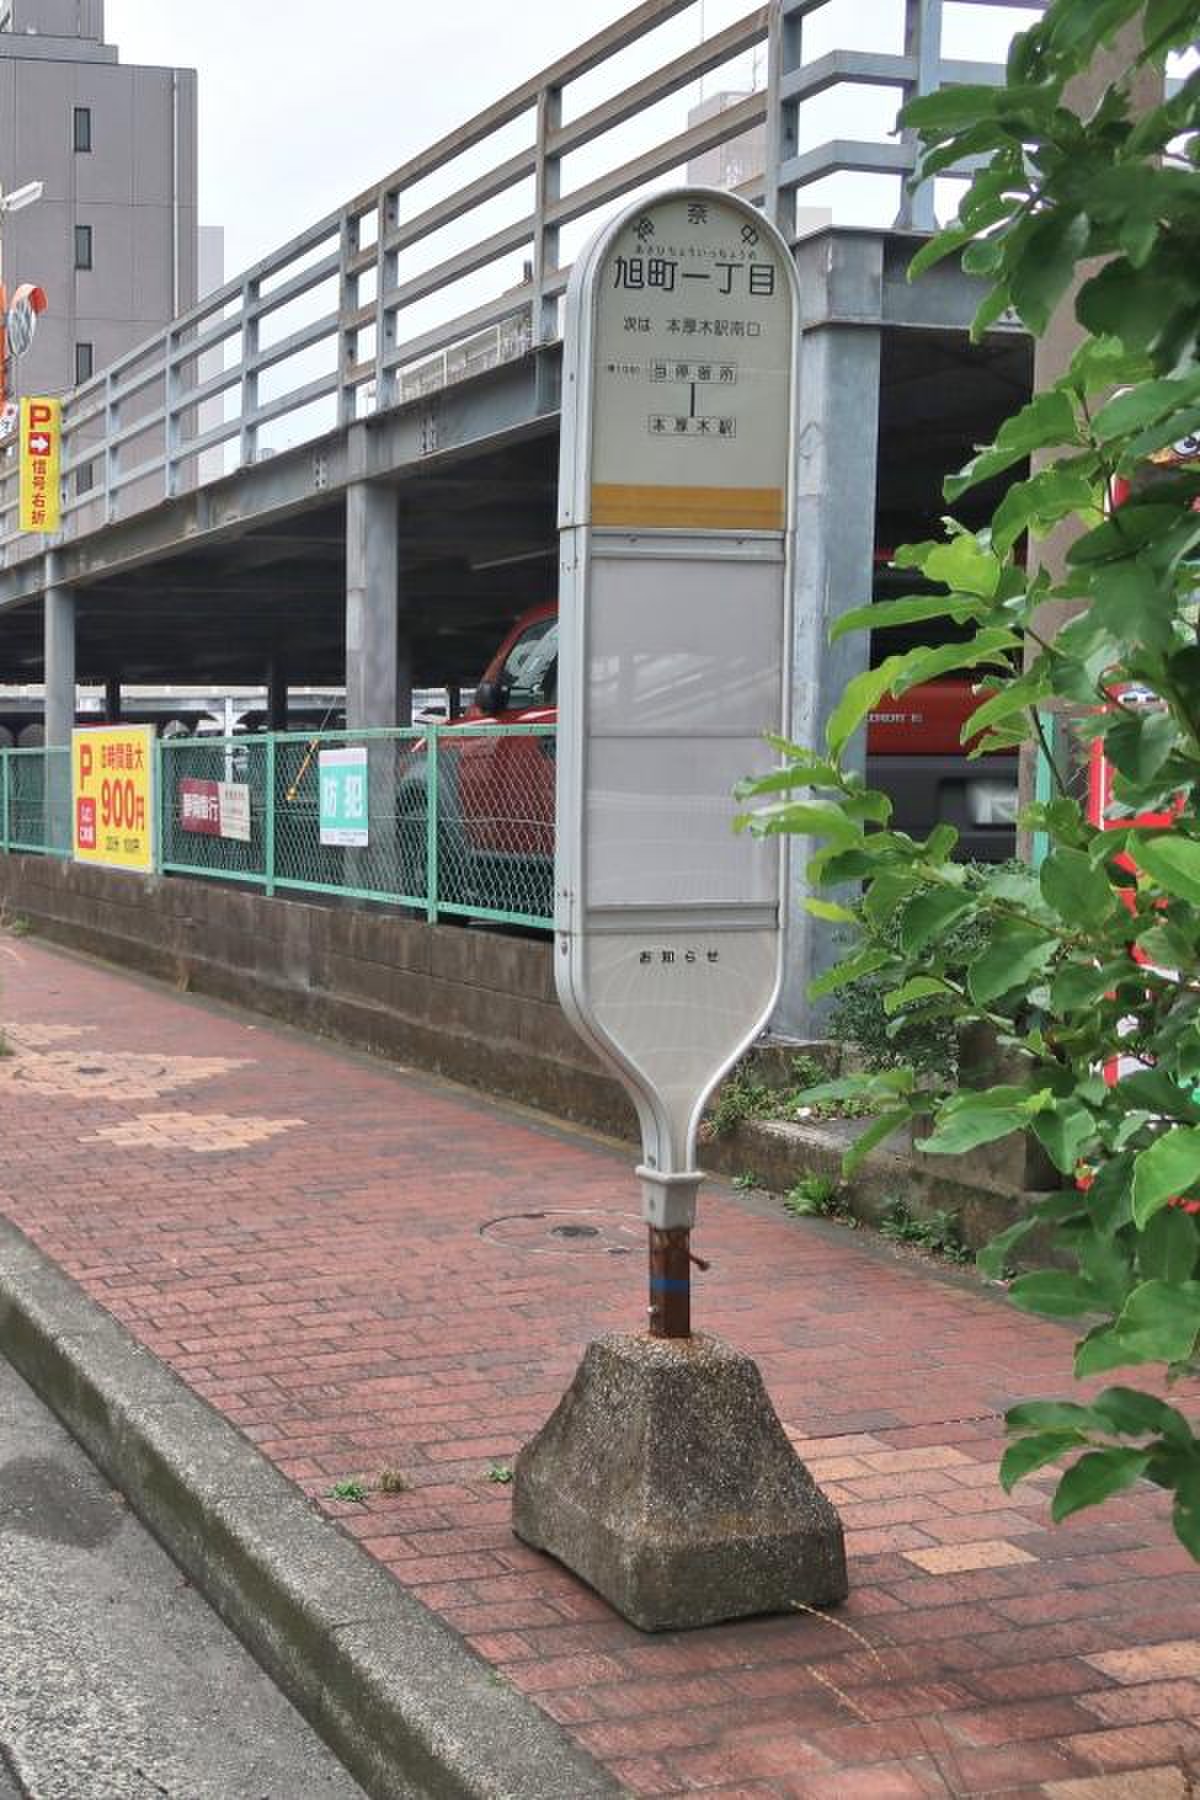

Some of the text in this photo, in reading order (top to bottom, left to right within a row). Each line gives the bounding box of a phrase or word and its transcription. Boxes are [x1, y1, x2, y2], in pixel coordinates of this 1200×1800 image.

[614, 256, 775, 296] 旭町一丁目
[623, 316, 761, 337] 次は 本厚木駅南口
[30, 405, 51, 429] P
[31, 458, 47, 526] 信号右折
[80, 744, 92, 791] P
[101, 778, 145, 831] 900円
[639, 949, 719, 965] お知らせ
